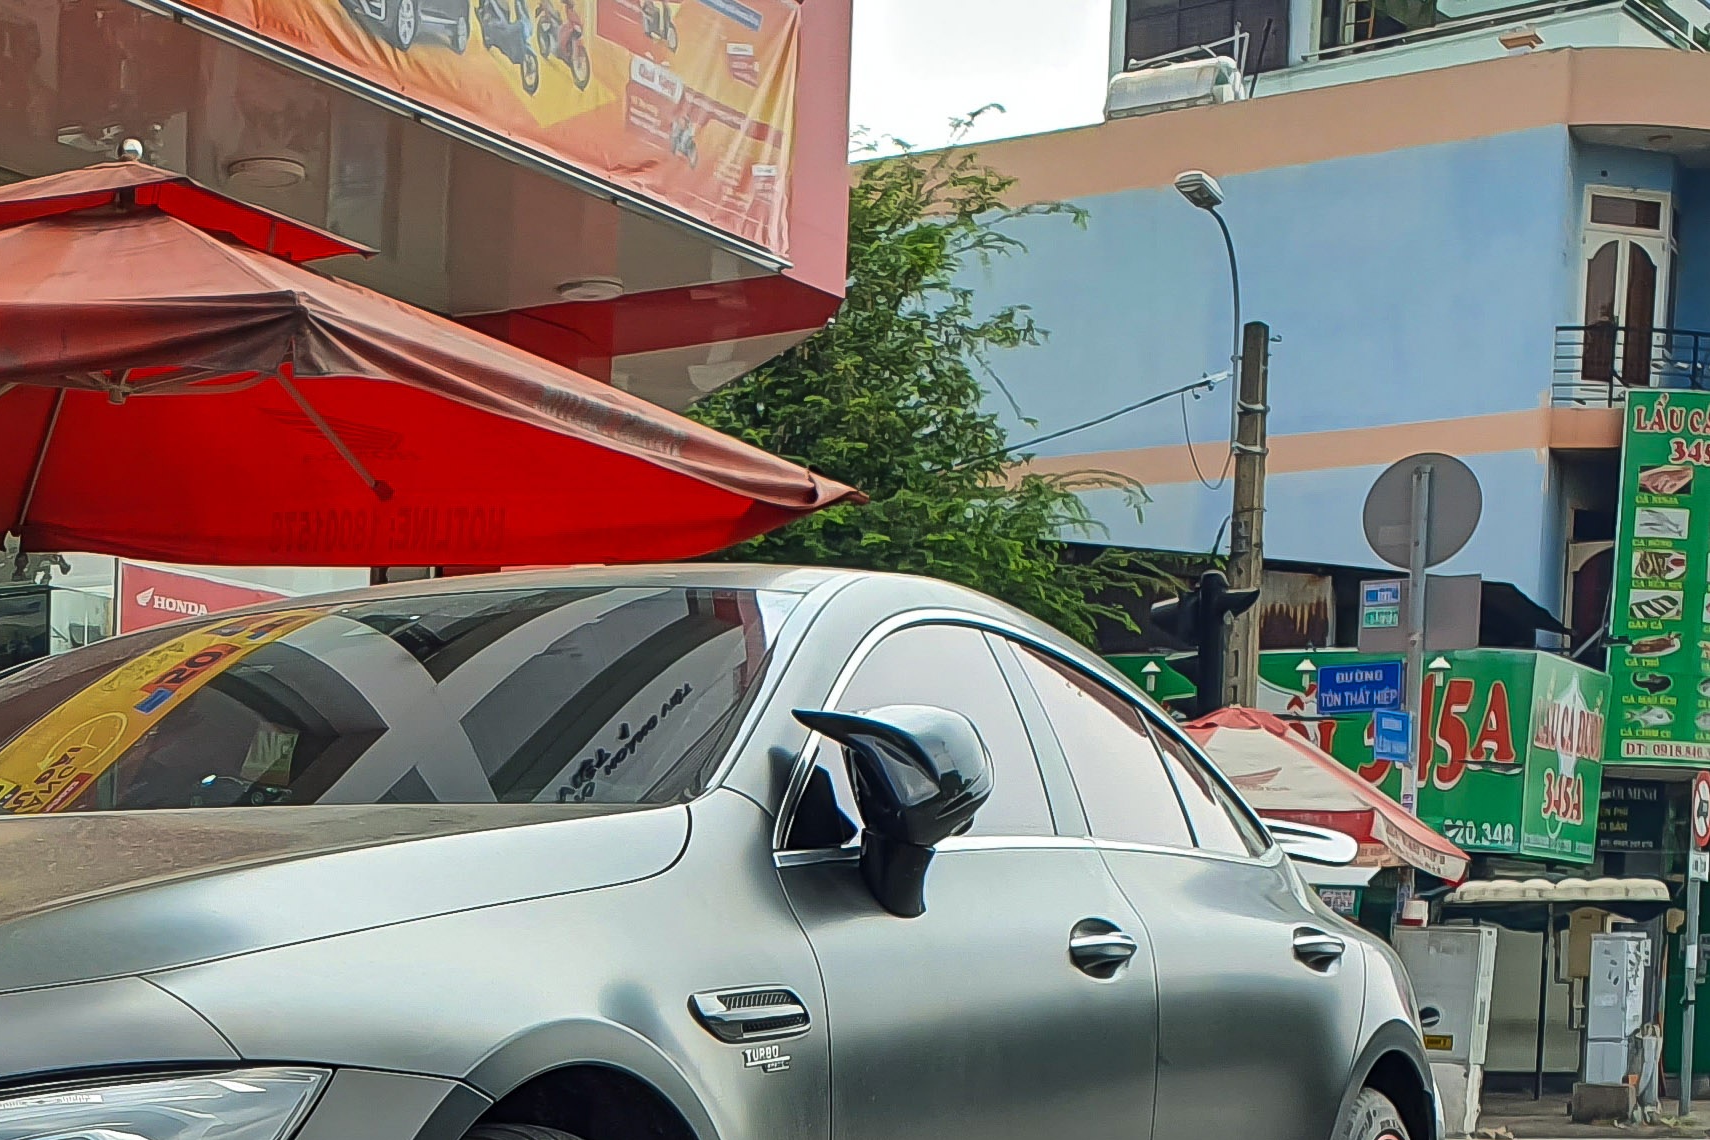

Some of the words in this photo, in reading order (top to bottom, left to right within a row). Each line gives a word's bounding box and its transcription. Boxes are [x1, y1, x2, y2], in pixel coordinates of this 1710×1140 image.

[152, 595, 208, 616] HONDA
[1336, 669, 1383, 684] ĐƯỜNG
[1321, 690, 1342, 707] TÔN
[1344, 685, 1371, 705] THẤT
[744, 1045, 780, 1063] TURBO
